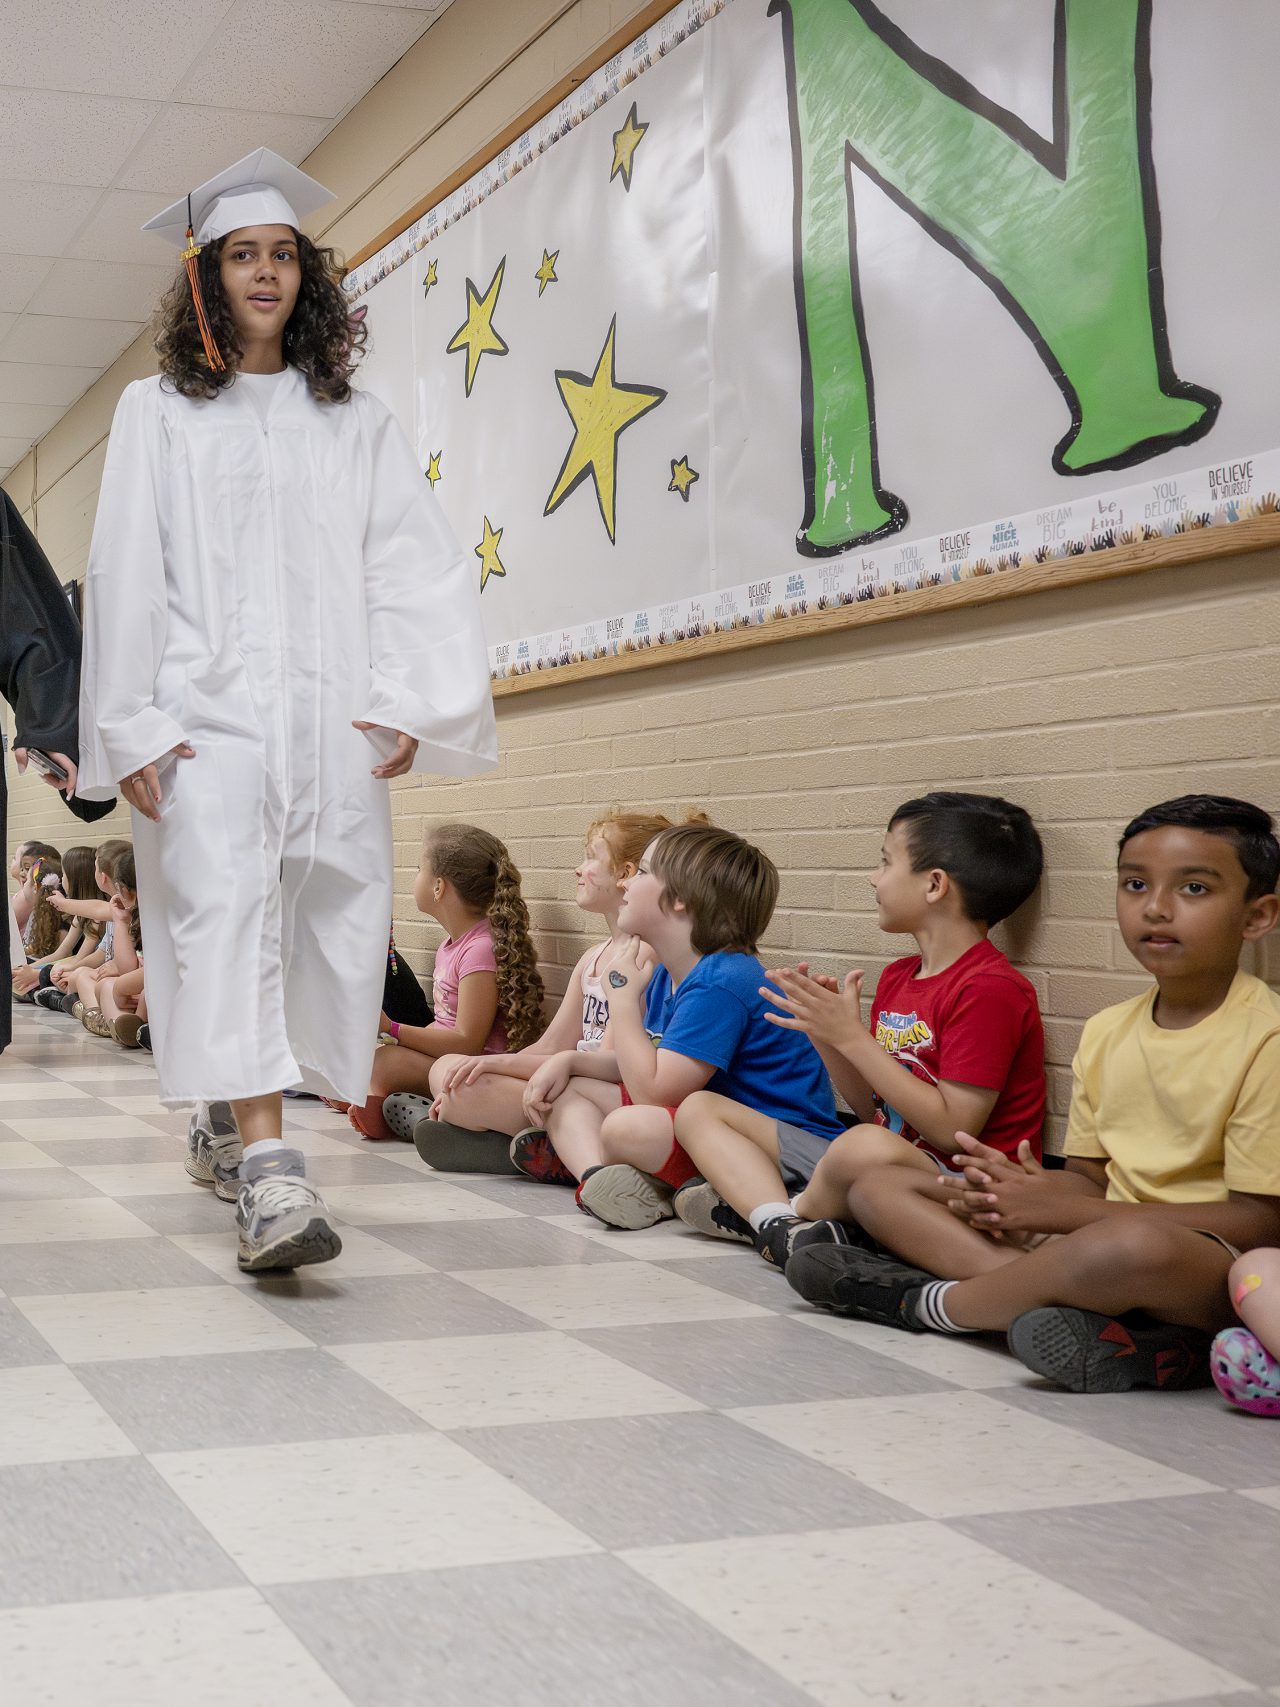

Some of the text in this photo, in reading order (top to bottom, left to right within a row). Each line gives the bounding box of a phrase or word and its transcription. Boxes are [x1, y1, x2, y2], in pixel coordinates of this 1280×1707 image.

[1209, 461, 1253, 487] BELIEVE
[1153, 481, 1177, 499] YOU
[1221, 479, 1251, 499] YOURSELF
[1098, 499, 1116, 514] be
[1144, 495, 1187, 519] BELONG
[1036, 507, 1073, 526] DREAM
[1091, 509, 1123, 531] kind
[992, 529, 1017, 544] NICE
[995, 523, 1005, 532] BE
[1043, 521, 1066, 543] BIG
[940, 532, 971, 552] BELIEVE
[990, 539, 1019, 552] HUMAN
[900, 546, 917, 561] YOU
[862, 558, 874, 570] be
[894, 557, 925, 577] BELONG
[857, 568, 880, 585] kind
[749, 581, 772, 598] BELIEVE
